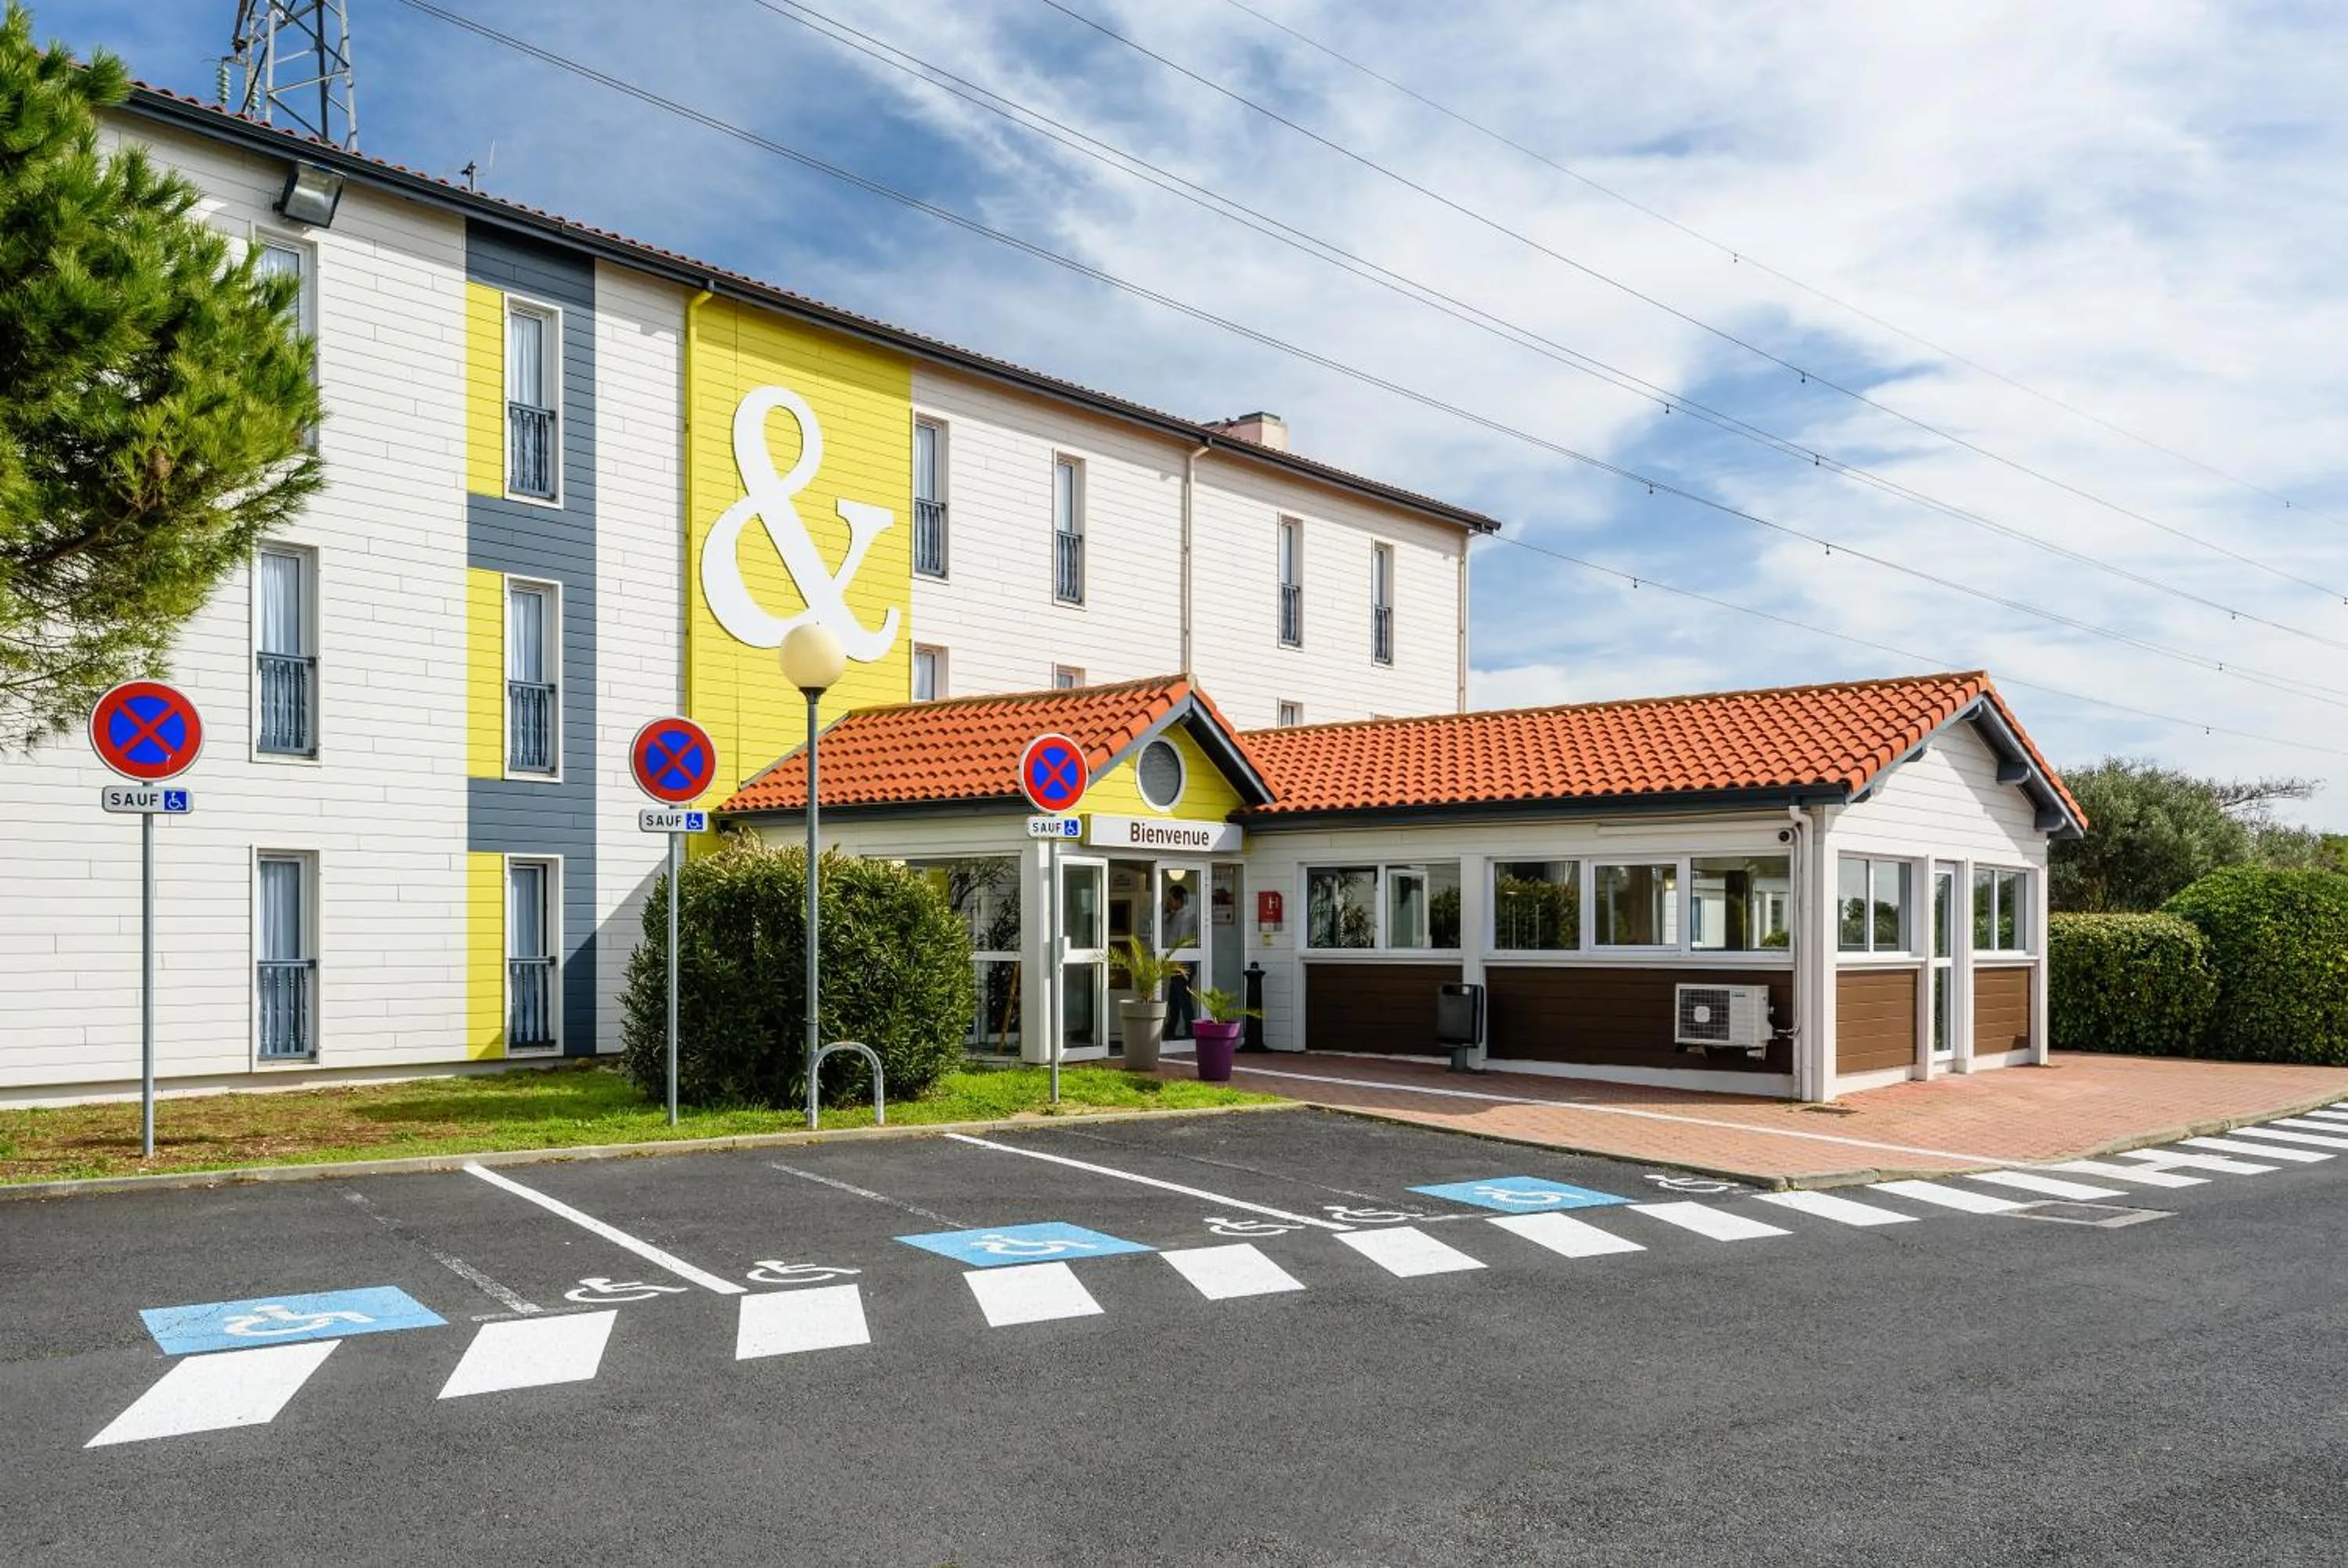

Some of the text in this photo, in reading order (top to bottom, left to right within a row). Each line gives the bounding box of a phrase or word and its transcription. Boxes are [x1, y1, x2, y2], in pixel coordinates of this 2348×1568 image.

[700, 385, 902, 664] &
[110, 793, 159, 806] SAUF
[646, 815, 682, 826] SAUF
[1033, 822, 1061, 833] SAUF
[1130, 822, 1209, 846] Bienvenue
